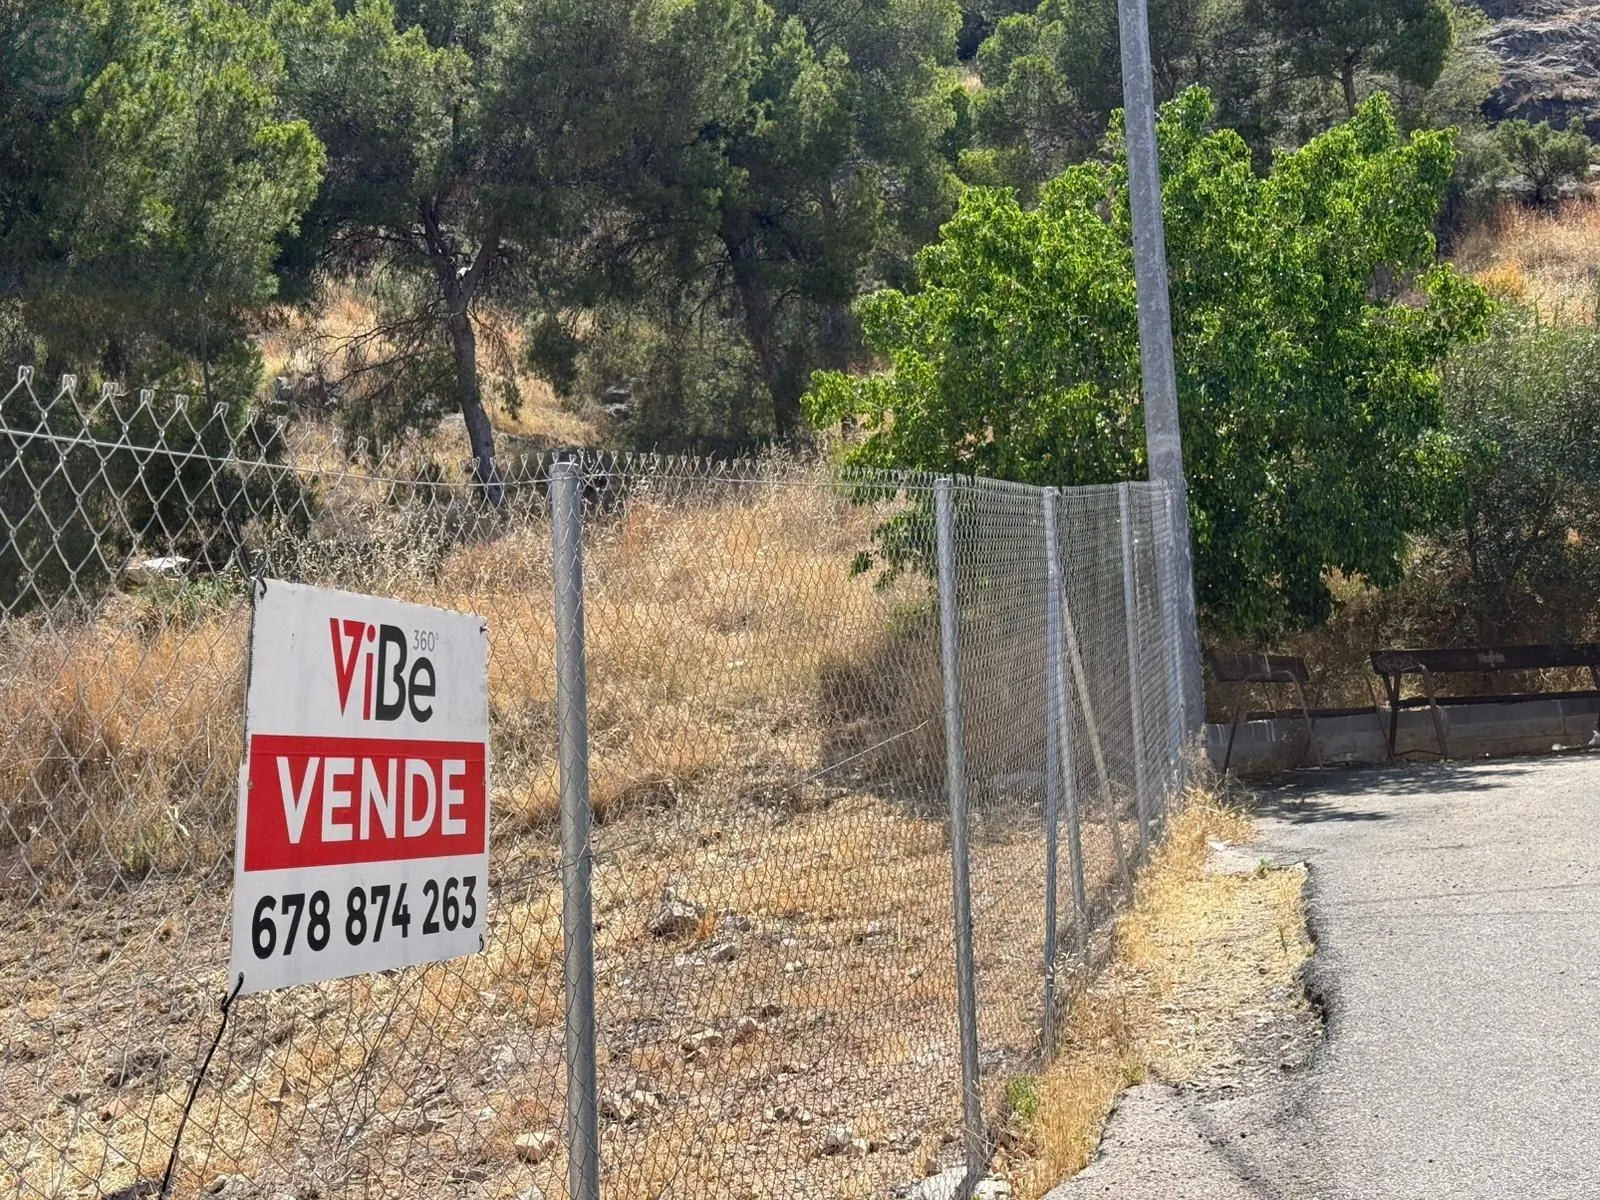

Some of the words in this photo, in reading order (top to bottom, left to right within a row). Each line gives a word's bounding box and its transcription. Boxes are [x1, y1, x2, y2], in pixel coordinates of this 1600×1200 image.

[329, 617, 436, 723] ViBe
[275, 756, 467, 845] VENDE
[251, 890, 331, 960] 678
[344, 882, 411, 947] 874
[421, 875, 477, 935] 263
